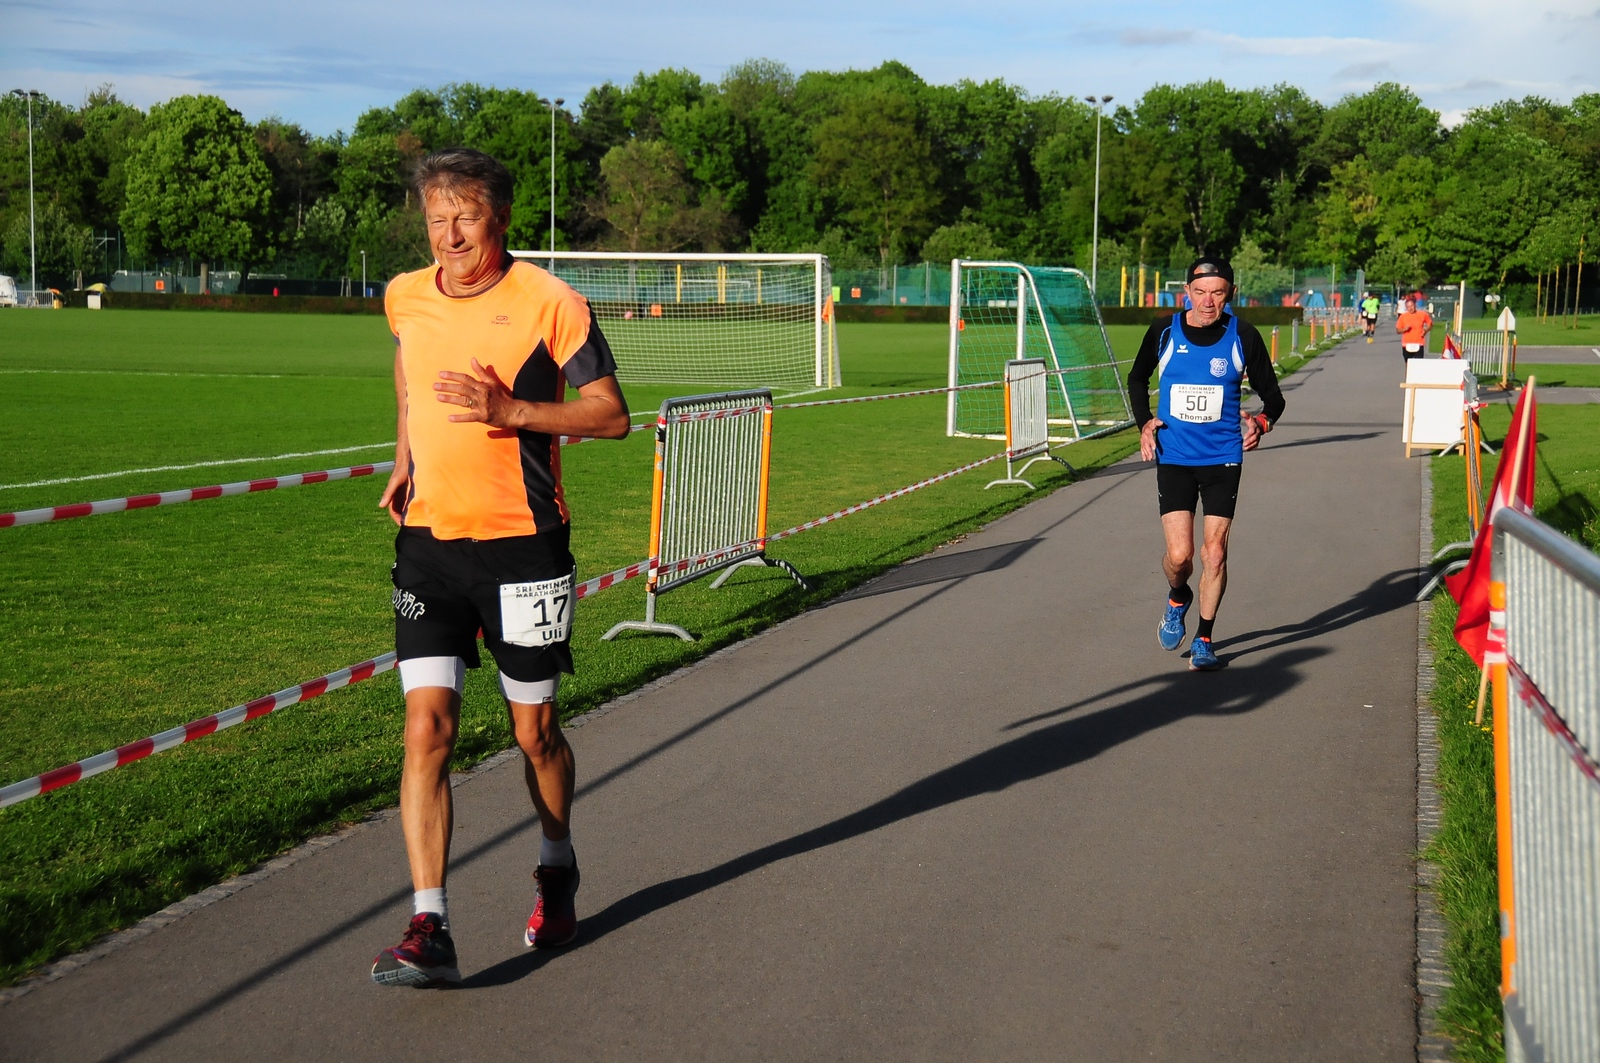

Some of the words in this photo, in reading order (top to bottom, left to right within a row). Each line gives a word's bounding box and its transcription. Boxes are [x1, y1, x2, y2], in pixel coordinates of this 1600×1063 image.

[1186, 395, 1207, 411] 50
[1179, 412, 1213, 421] Thomas
[515, 586, 532, 594] SRI
[516, 588, 560, 598] MARATHON
[532, 593, 568, 628] 17
[542, 628, 562, 641] Uli
